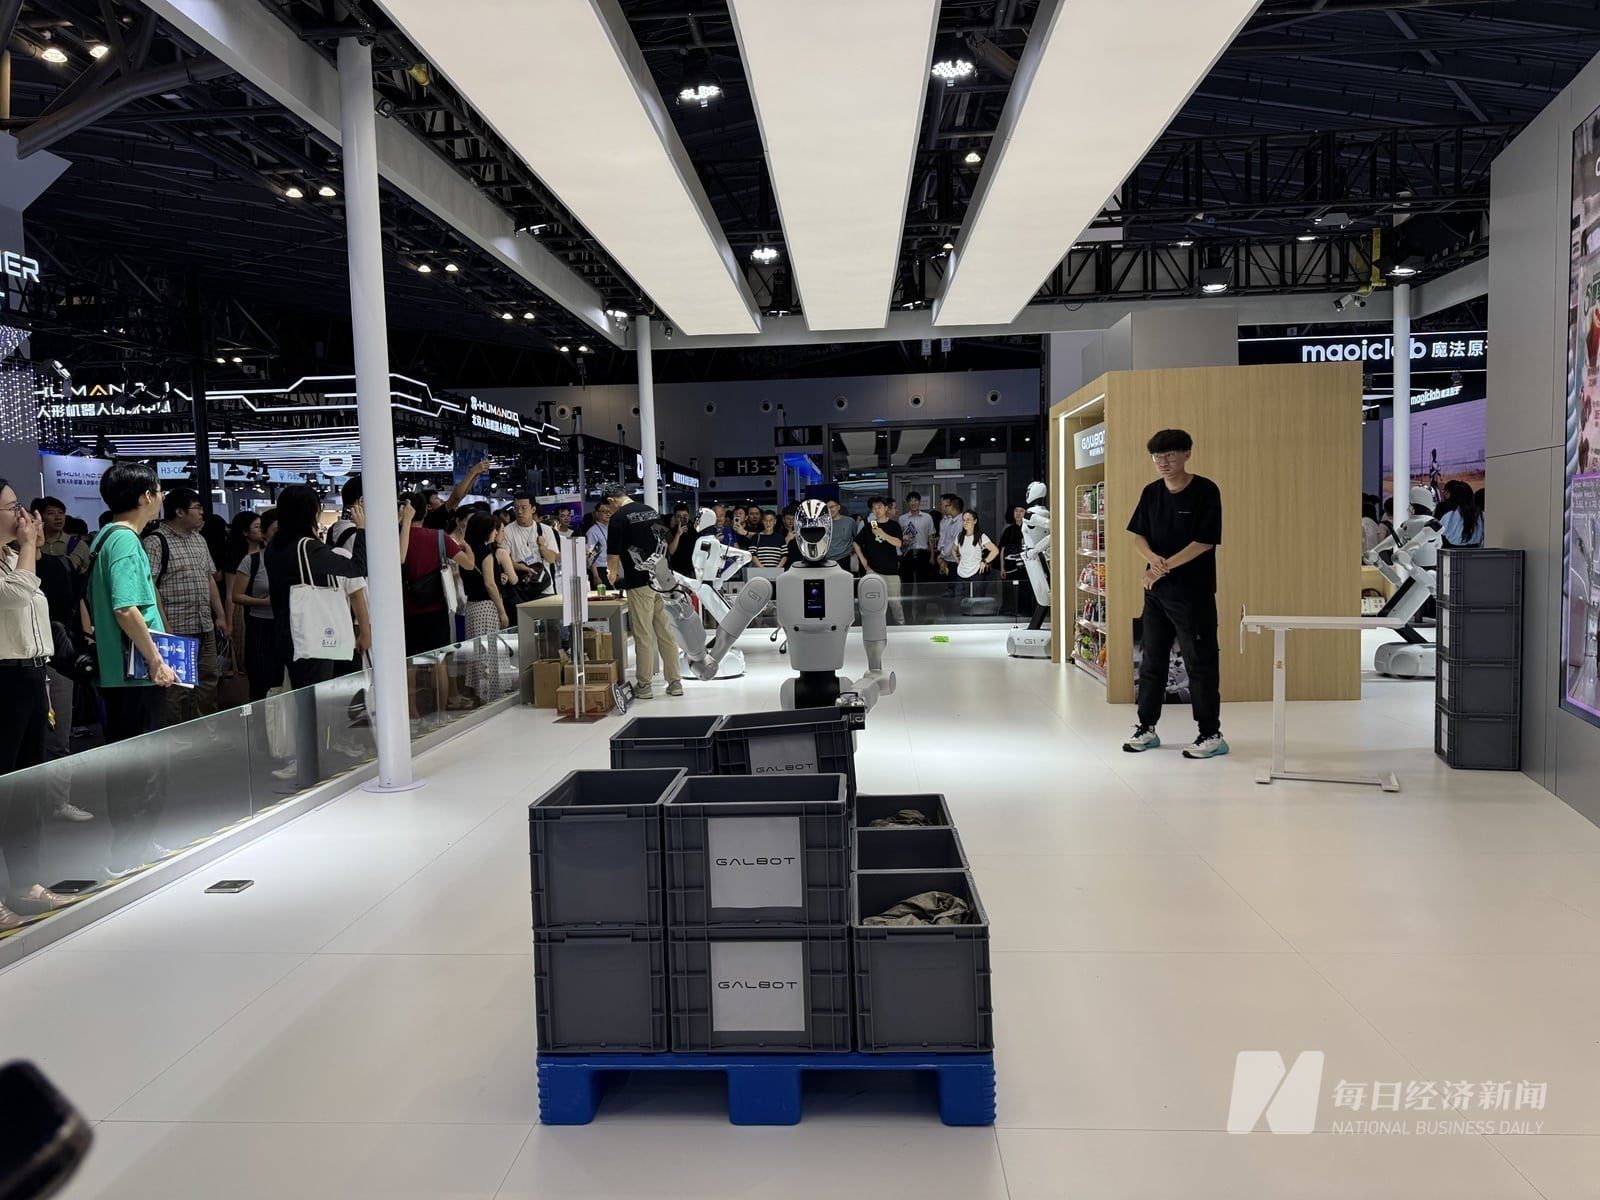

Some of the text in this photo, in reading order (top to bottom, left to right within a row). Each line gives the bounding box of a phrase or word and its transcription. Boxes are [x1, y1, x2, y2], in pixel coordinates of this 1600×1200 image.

[0, 250, 40, 283] ER
[1431, 339, 1488, 358] 魔法原
[755, 763, 814, 774] GALBOT
[716, 857, 796, 866] GALBOT
[718, 981, 798, 990] GALBOT
